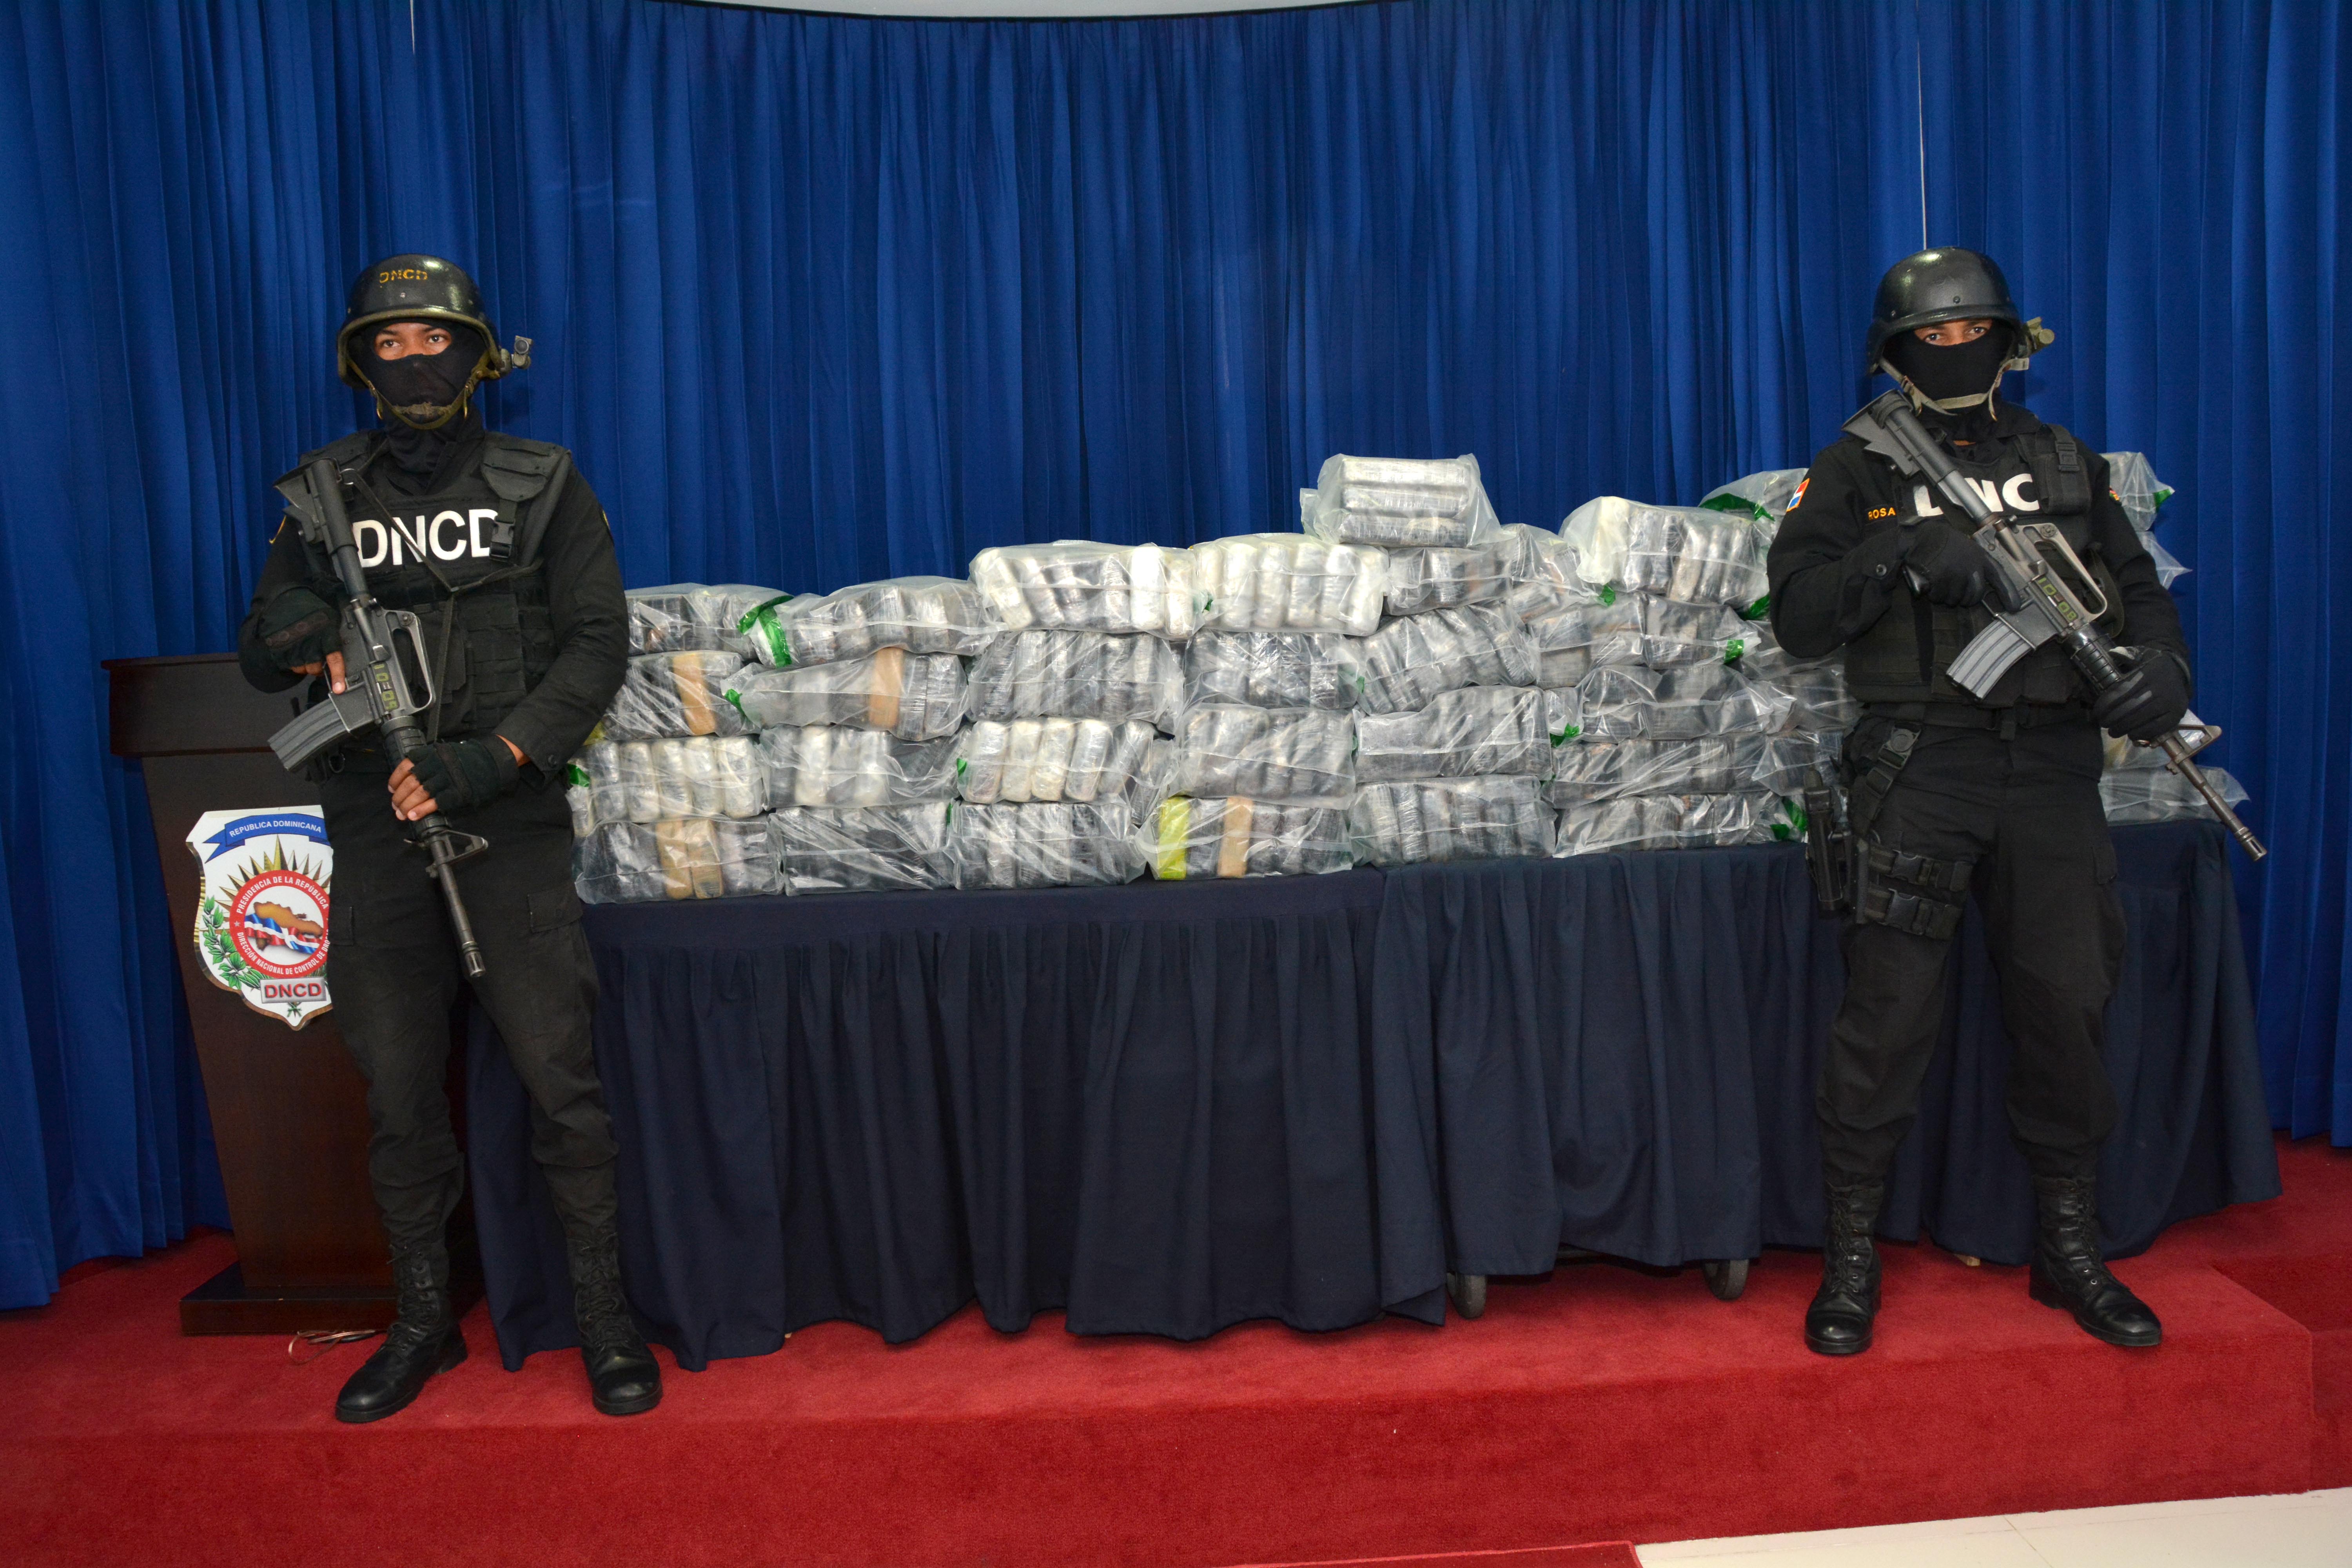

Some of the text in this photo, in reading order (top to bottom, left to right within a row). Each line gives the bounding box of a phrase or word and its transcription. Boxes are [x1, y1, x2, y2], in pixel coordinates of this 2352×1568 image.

[379, 269, 428, 283] DNCD
[1867, 507, 1896, 521] ROSA
[353, 508, 498, 568] DNCD
[229, 820, 321, 837] REPUBLICA DOMINICANA
[236, 878, 272, 914] PRESIDENCIA
[295, 878, 329, 909] REPÚBLICA
[237, 932, 258, 962] DIRECCIÓN
[256, 958, 284, 975] NACIONAL
[294, 958, 319, 974] CONTROL
[316, 951, 325, 960] DE
[265, 983, 322, 998] DNCD
